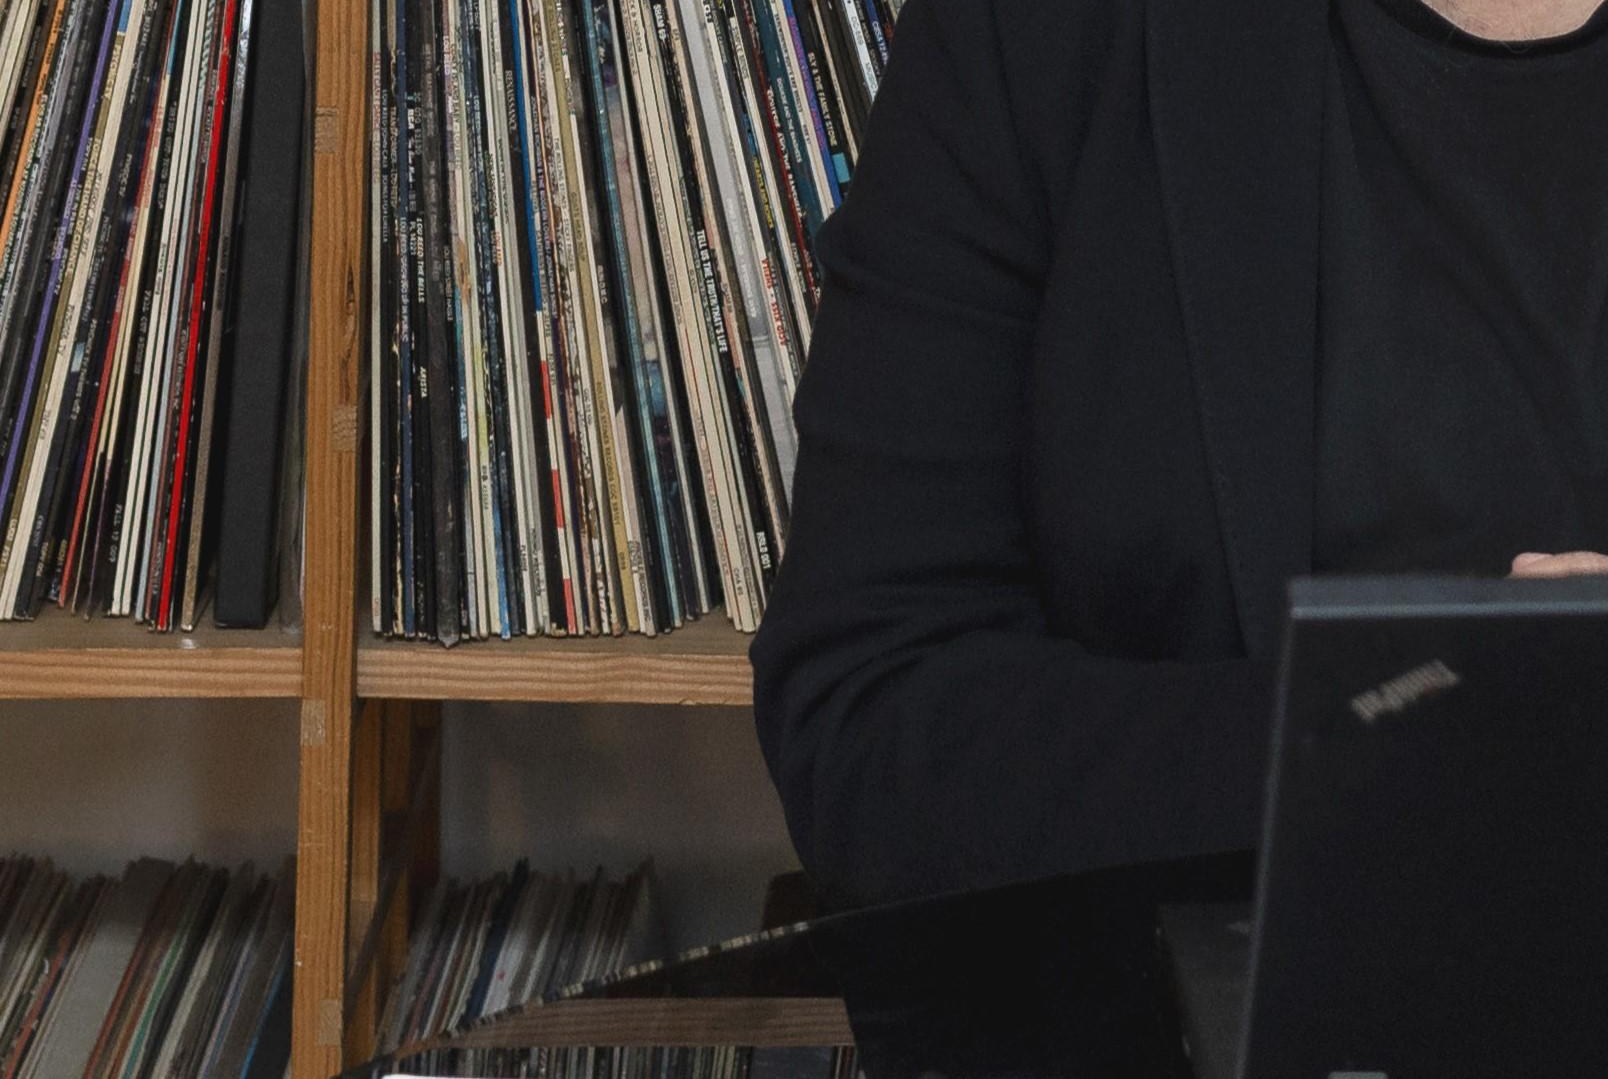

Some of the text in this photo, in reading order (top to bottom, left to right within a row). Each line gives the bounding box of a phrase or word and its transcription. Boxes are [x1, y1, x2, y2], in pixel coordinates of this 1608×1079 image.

[631, 19, 642, 53] HORROR
[731, 25, 749, 79] SIMPLE MINDS
[807, 51, 818, 67] SLY
[813, 75, 824, 90] THE
[503, 69, 517, 133] RENAISSANCE
[529, 95, 539, 132] JONATHAN
[817, 91, 831, 119] FAMILY
[782, 105, 795, 131] AND THE
[824, 119, 837, 147] STONE
[87, 137, 100, 169] FORCE
[533, 133, 542, 166] RICHMAN
[652, 3, 728, 353] SHAM 69 TELL US THE LIFE
[77, 189, 90, 218] HAND
[538, 189, 547, 219] MODERN
[555, 151, 564, 181] ROLLING
[566, 243, 575, 272] FINGERS
[415, 217, 423, 235] LOU
[66, 233, 80, 274] CHANCE
[415, 236, 423, 258] REED
[416, 260, 424, 276] THE
[545, 254, 556, 292] JONATHAN
[419, 366, 427, 398] ARISTA
[595, 381, 615, 482] ROLLING STONES RECORDS
